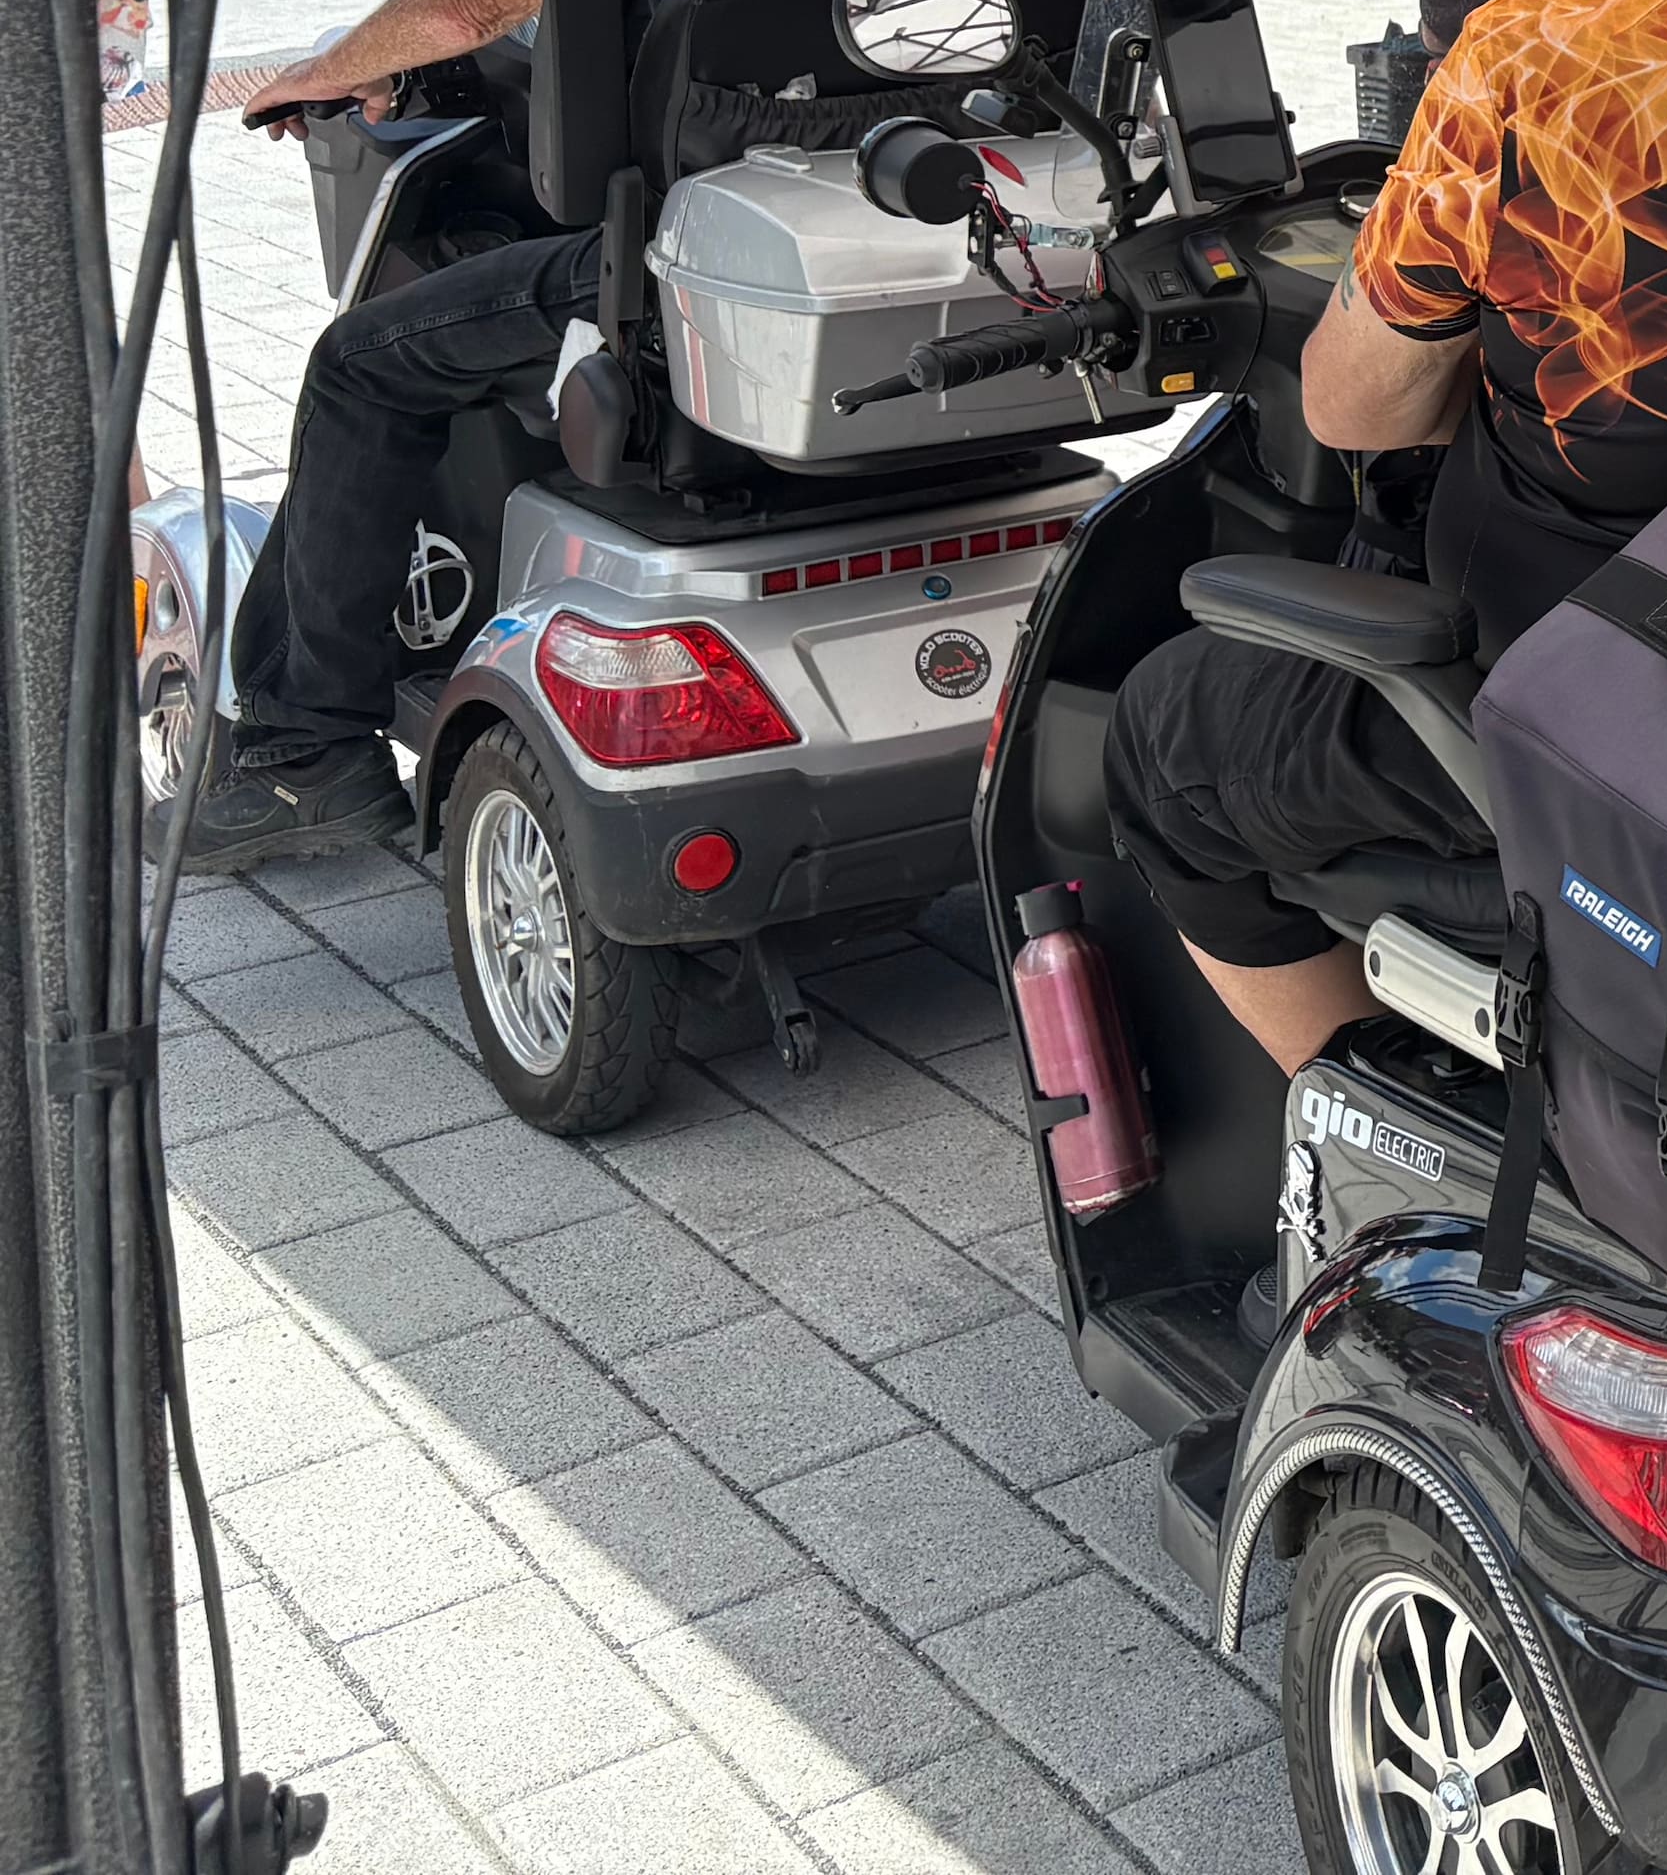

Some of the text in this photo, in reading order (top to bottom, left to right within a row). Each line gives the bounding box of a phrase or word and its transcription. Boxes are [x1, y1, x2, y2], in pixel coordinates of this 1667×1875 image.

[934, 632, 984, 656] SCOOTER
[1566, 880, 1654, 952] RALEIGH
[1301, 1087, 1440, 1176] gio ELECTRIC
